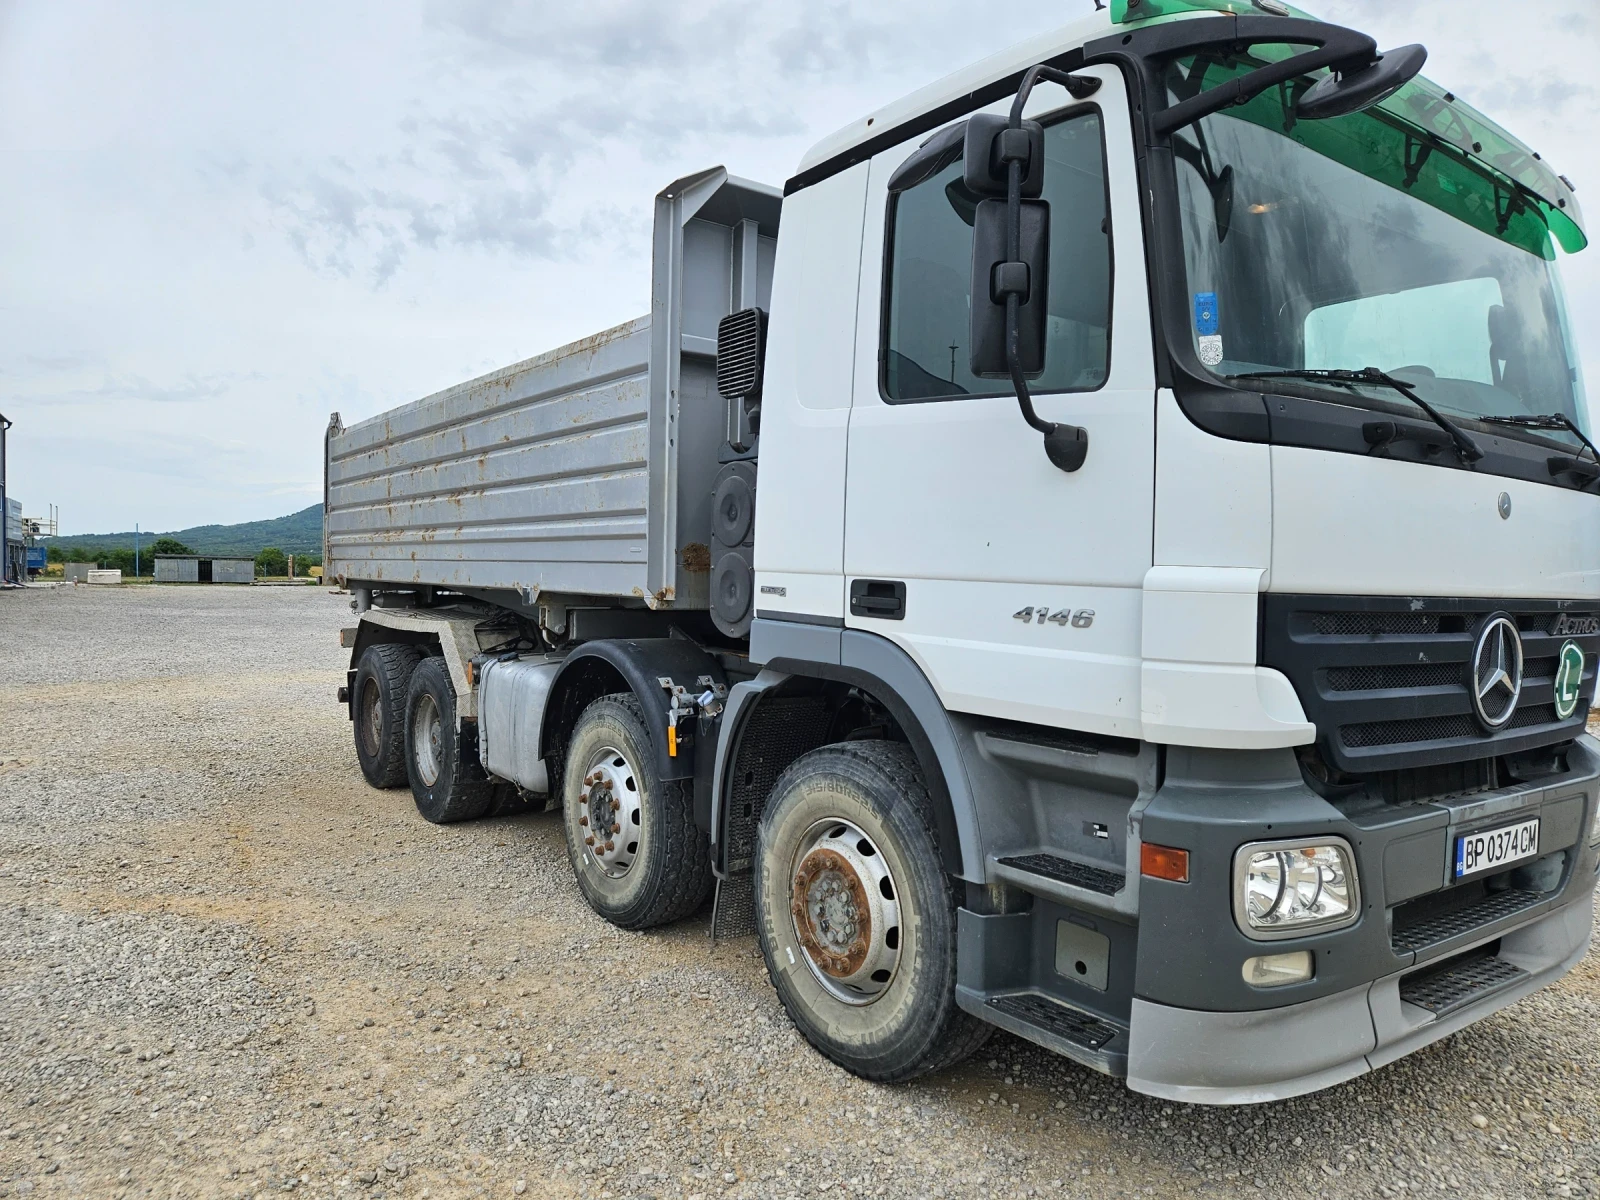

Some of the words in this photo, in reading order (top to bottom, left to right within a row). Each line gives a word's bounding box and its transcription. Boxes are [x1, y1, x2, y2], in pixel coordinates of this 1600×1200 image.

[1012, 606, 1095, 628] 4146
[1562, 659, 1573, 701] L
[1466, 837, 1484, 869] BP
[1487, 828, 1518, 863] 0374
[1520, 824, 1537, 853] CM
